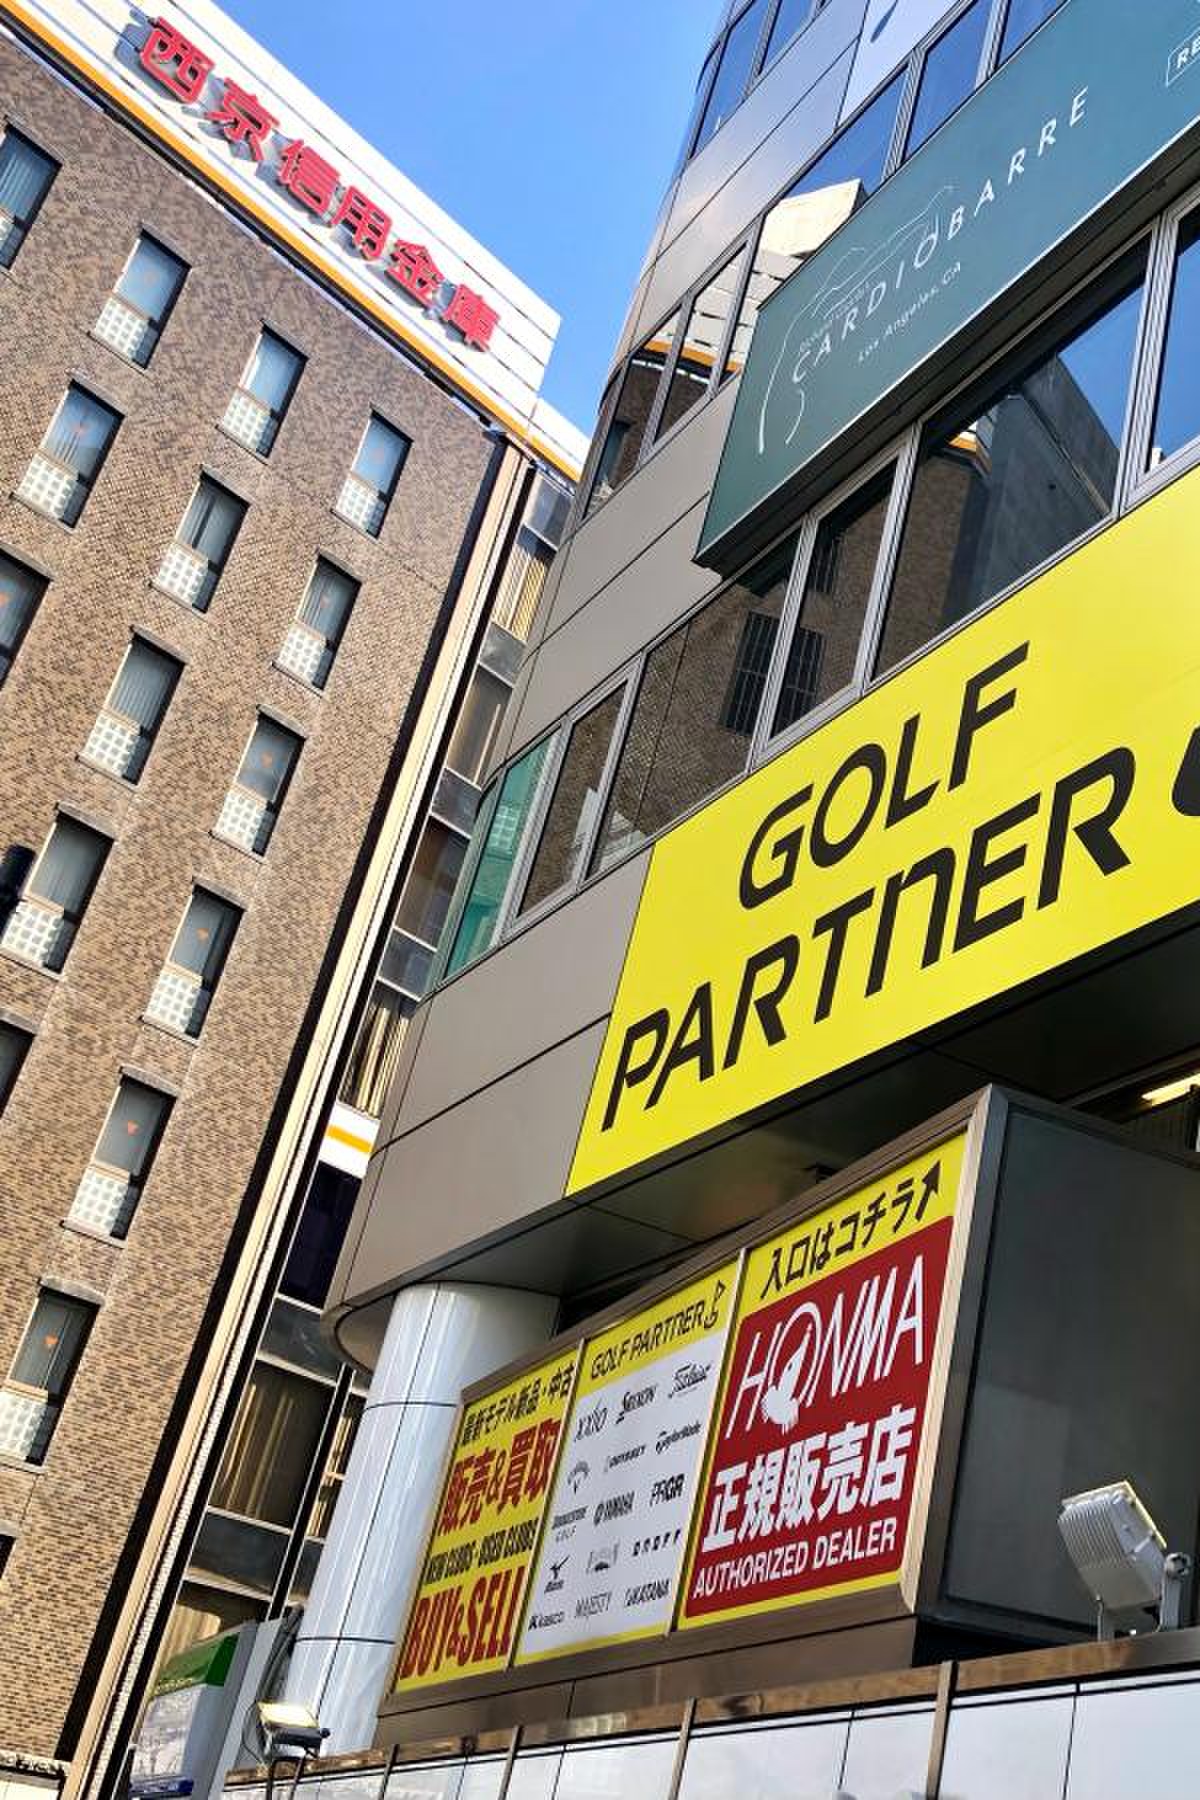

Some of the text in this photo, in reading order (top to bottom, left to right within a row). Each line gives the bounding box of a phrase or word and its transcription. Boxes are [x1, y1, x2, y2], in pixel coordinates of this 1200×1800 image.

[139, 16, 500, 352] 西京信用金庫
[792, 85, 1088, 384] CARDIOBARRE
[738, 640, 1031, 911] GOLF
[761, 1177, 915, 1300] 入口はコチラ
[591, 1338, 631, 1380] GOLF
[726, 1254, 924, 1440] HONMA
[692, 1516, 897, 1600] AUTHORIZED DEALER
[702, 1403, 917, 1553] 正規販売店
